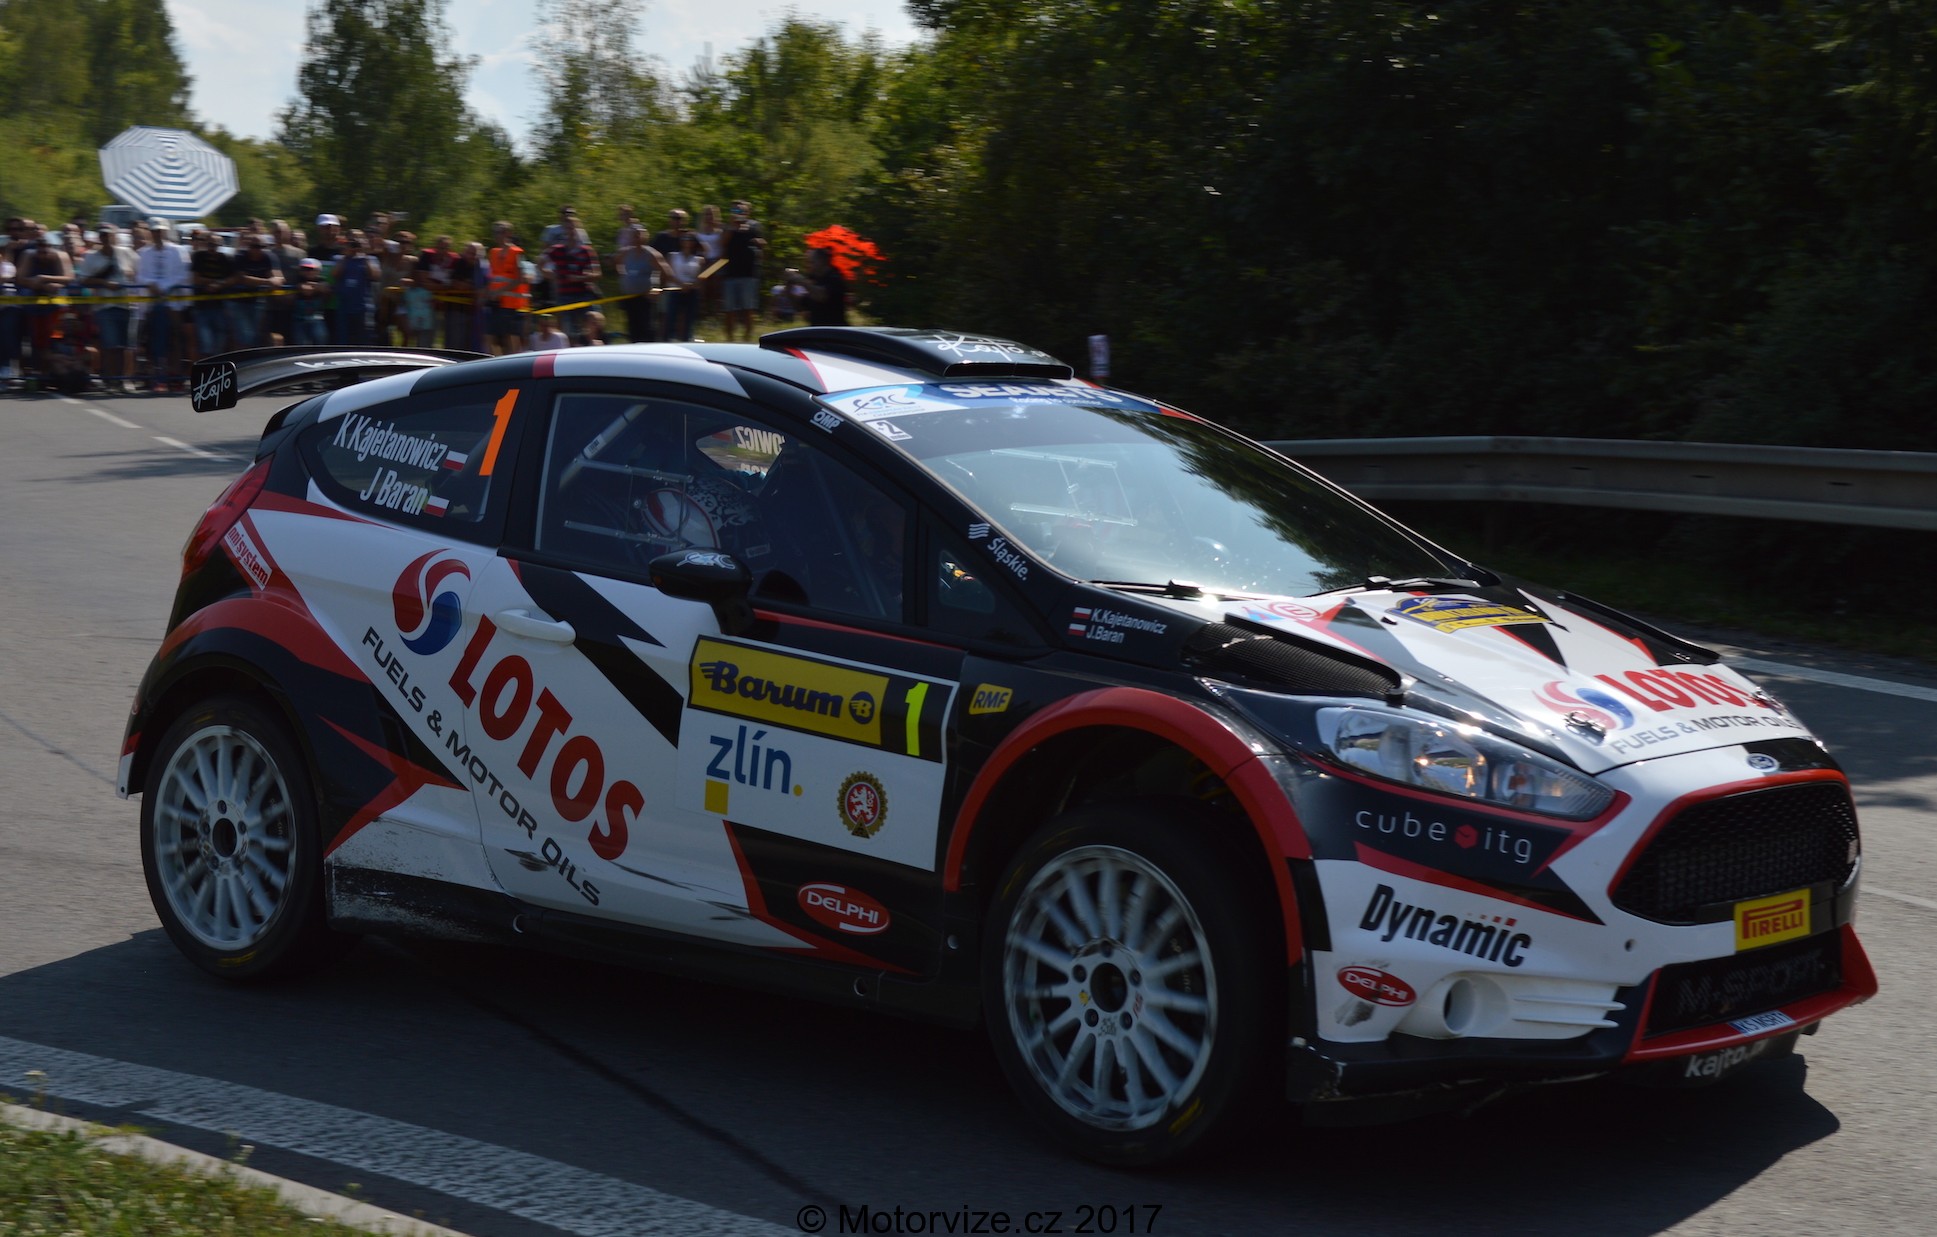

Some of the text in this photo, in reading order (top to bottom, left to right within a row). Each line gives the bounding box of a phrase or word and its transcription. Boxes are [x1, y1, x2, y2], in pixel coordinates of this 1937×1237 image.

[333, 412, 448, 472] K Kajetanowicz
[479, 388, 520, 477] 1
[813, 411, 841, 430] OMP
[360, 467, 429, 516] J Baran
[699, 661, 843, 718] Barum
[973, 690, 1009, 709] RMF
[448, 613, 646, 861] LOTOS
[905, 681, 930, 757] 1
[1610, 725, 1679, 755] FUELS
[1676, 721, 1700, 735] &
[1690, 714, 1762, 731] MOTOR
[362, 626, 602, 906] FUELS & MOTOR OILS
[1355, 810, 1533, 864] cube itg
[806, 890, 880, 925] DELPHI
[1358, 883, 1532, 968] Dynamic
[1742, 899, 1805, 940] PIRELLI
[1344, 971, 1410, 1001] DELPHI
